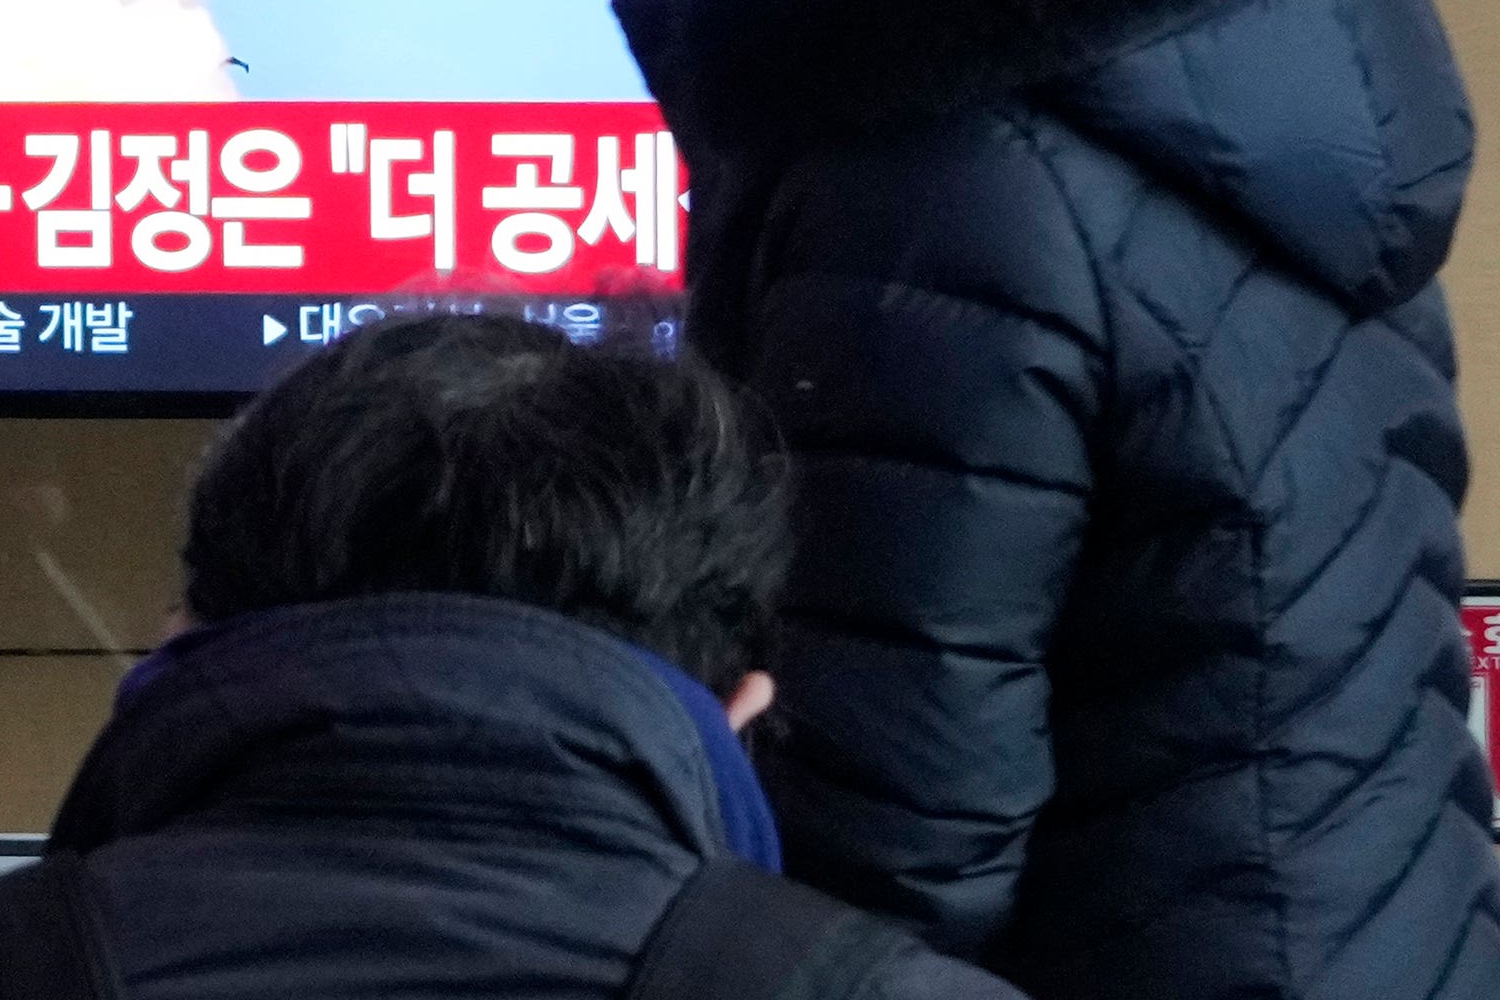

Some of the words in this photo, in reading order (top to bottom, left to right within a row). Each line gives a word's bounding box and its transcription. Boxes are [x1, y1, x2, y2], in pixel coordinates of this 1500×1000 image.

[330, 123, 456, 275] "더
[481, 130, 690, 275] 공세
[38, 301, 134, 353] 개발
